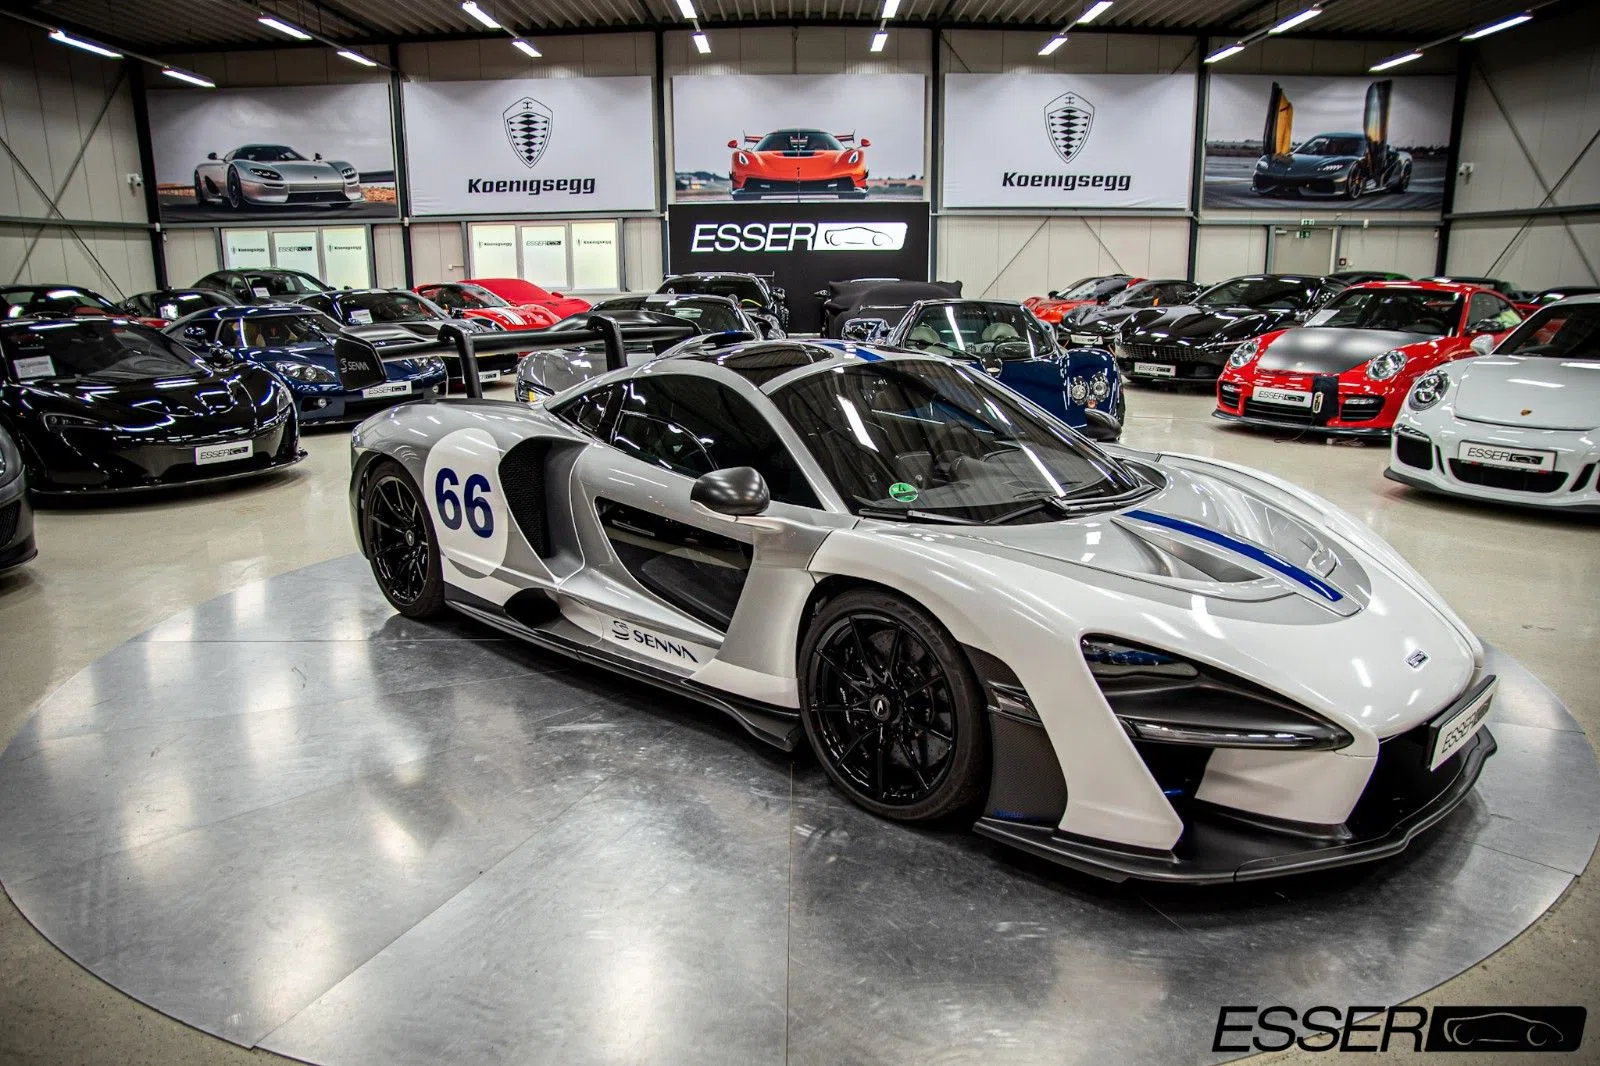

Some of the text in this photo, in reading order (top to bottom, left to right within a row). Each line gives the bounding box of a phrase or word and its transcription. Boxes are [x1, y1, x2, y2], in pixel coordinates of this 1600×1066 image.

[468, 178, 595, 195] Koenigsegg
[1002, 172, 1131, 191] Koenigsegg
[691, 223, 816, 252] ESSER
[369, 386, 392, 395] ESSER
[1259, 390, 1285, 399] ESSER
[201, 448, 231, 459] ESSER
[1468, 447, 1510, 461] ESSER
[435, 468, 494, 538] 66
[633, 630, 699, 664] SENNA
